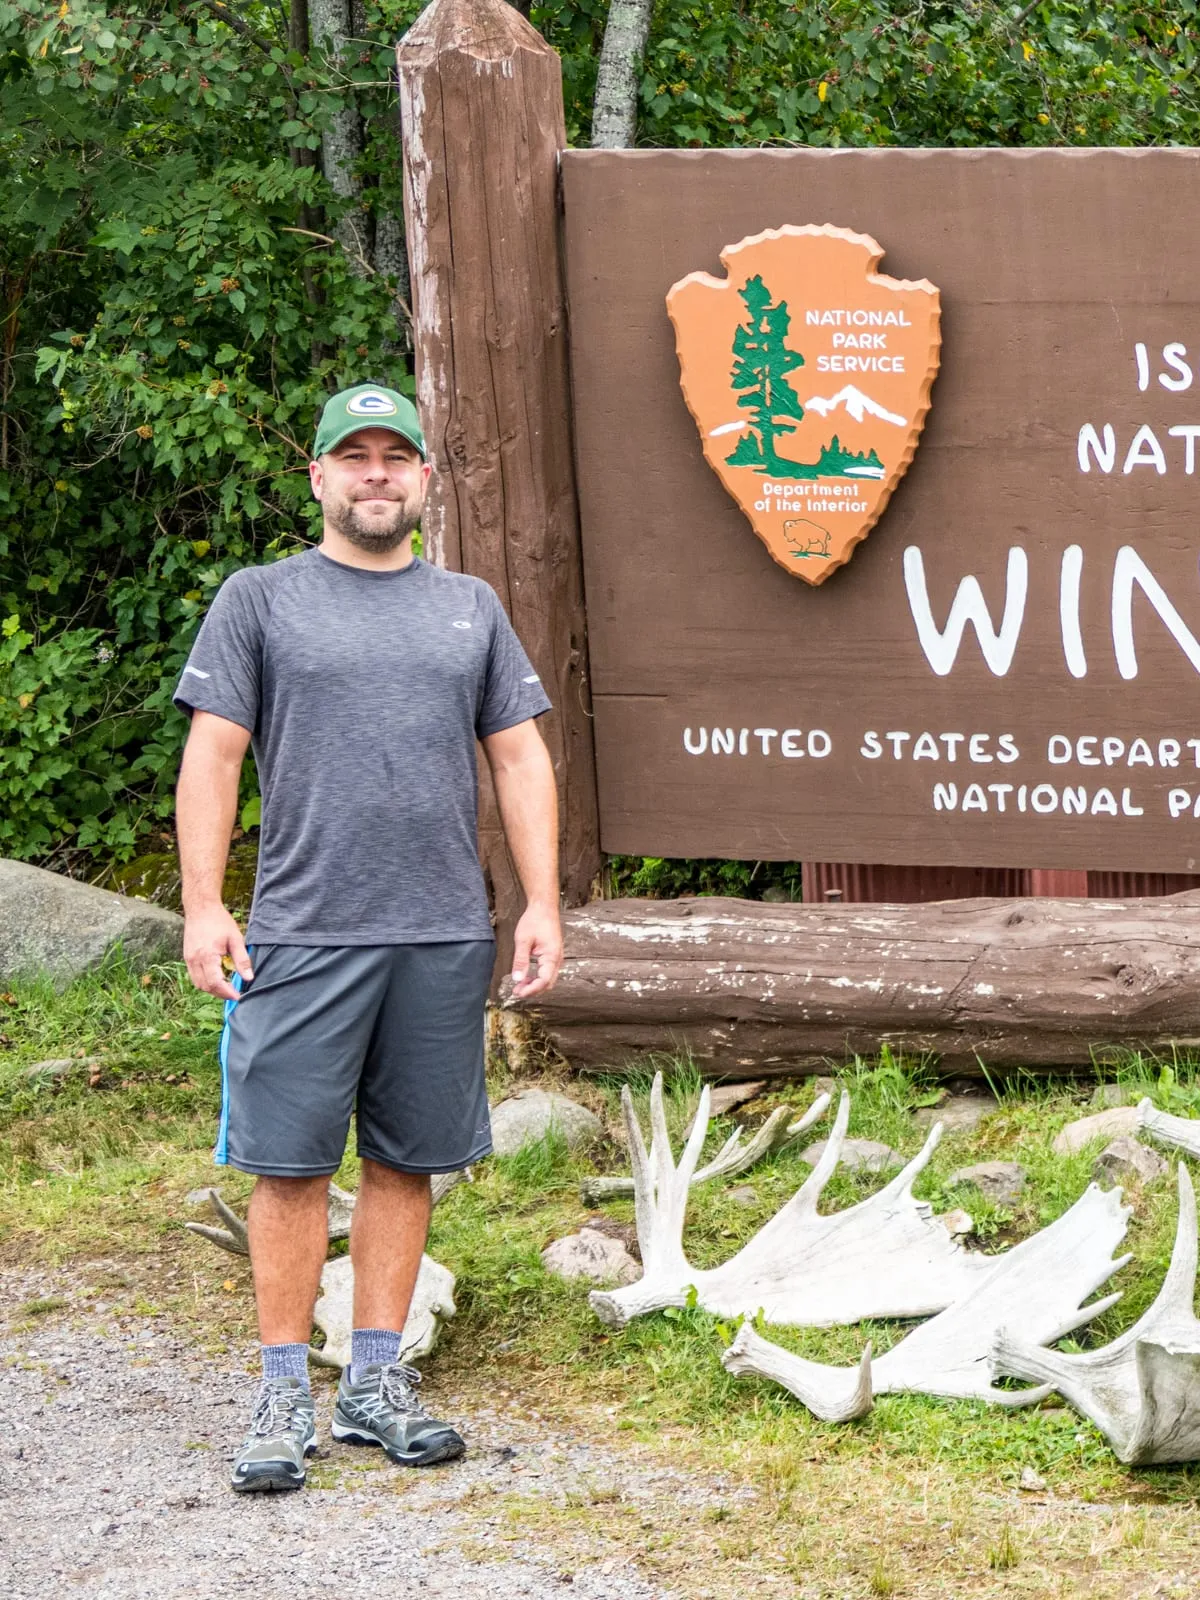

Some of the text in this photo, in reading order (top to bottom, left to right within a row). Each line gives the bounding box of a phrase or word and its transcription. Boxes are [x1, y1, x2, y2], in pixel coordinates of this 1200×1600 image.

[805, 310, 911, 327] NATIONAL
[832, 332, 887, 349] PARK
[816, 355, 904, 373] SERVICE
[763, 482, 859, 498] Department
[754, 497, 868, 513] of the Interior
[683, 727, 832, 758] UNITED
[860, 730, 1020, 764] STATES
[932, 782, 1144, 817] NATIONAL
